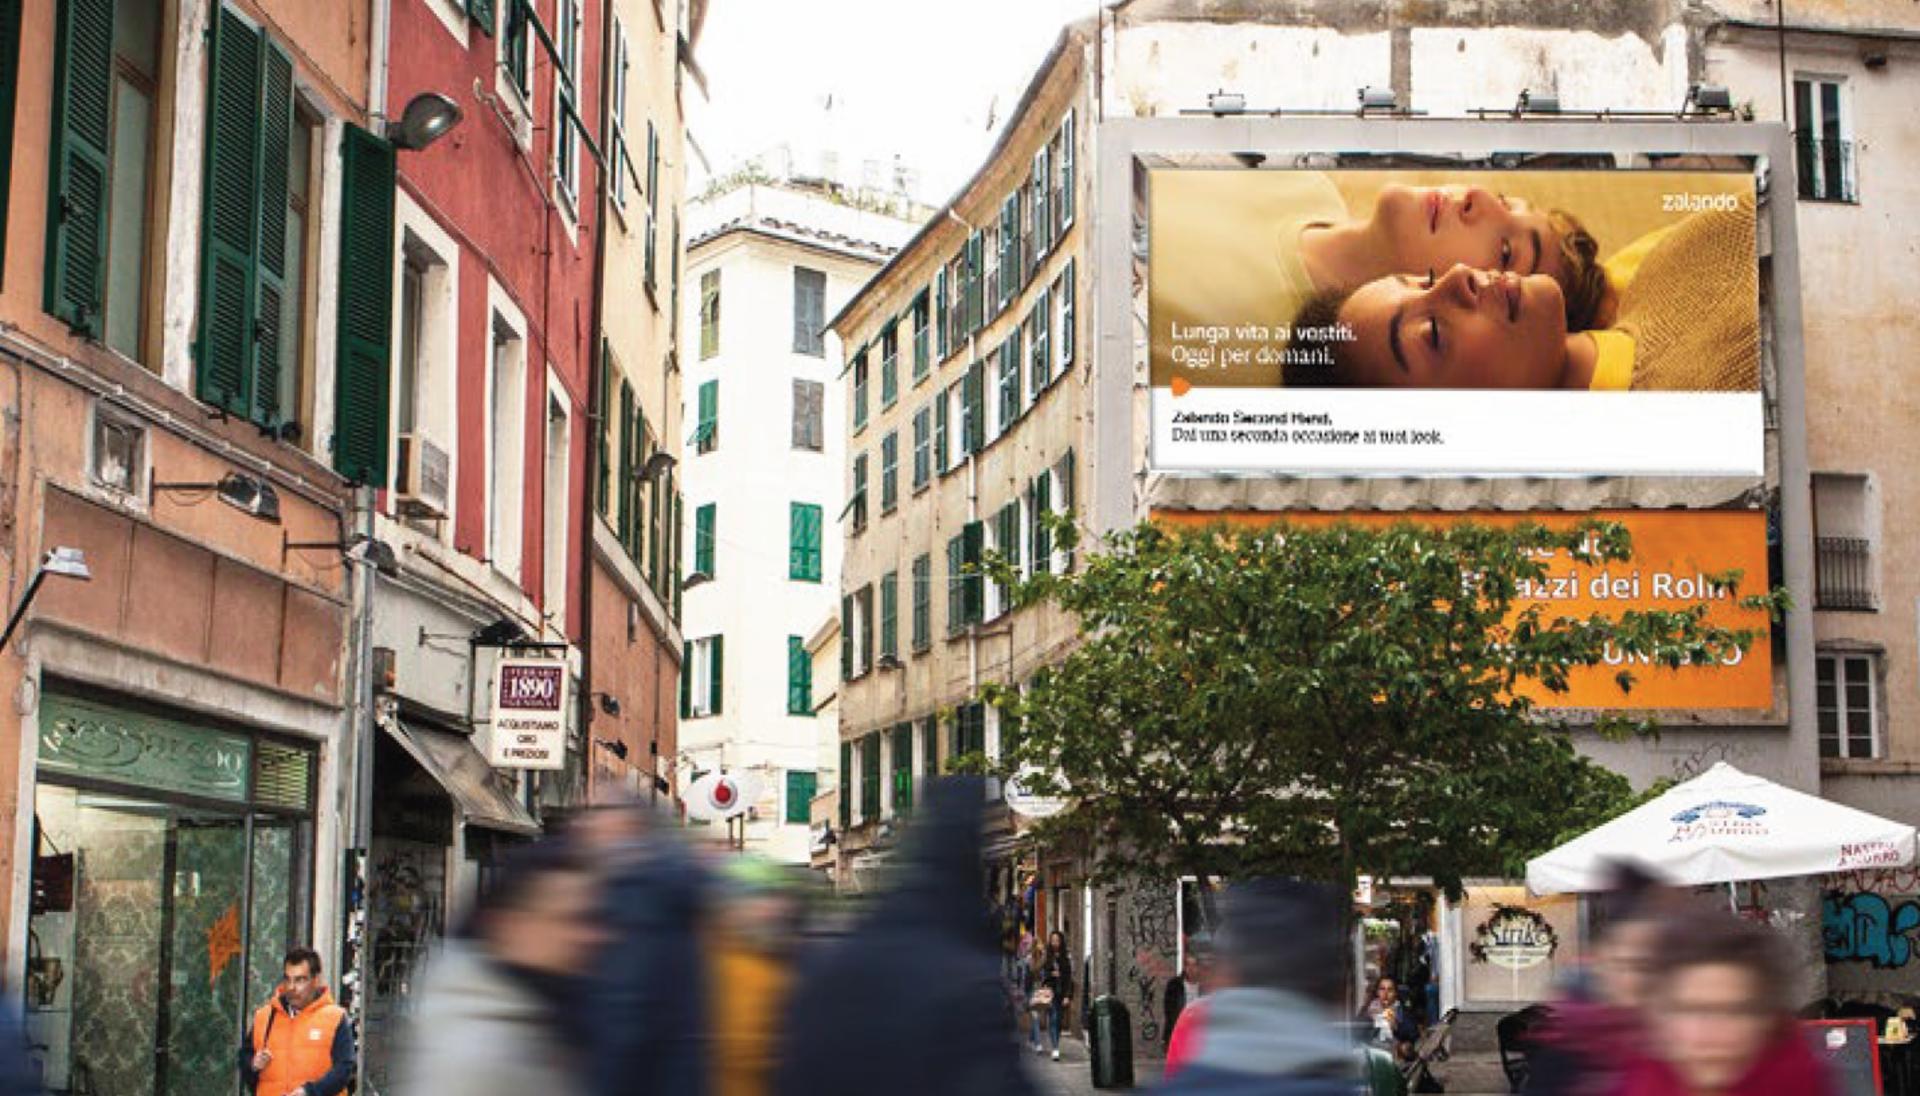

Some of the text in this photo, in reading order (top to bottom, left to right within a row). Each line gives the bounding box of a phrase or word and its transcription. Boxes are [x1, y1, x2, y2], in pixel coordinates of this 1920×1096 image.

[1662, 191, 1738, 212] zalando
[1171, 321, 1230, 345] Lunga
[1235, 322, 1269, 342] vita
[1274, 322, 1291, 341] ai
[1171, 344, 1336, 370] Oggi per domani.
[1233, 410, 1287, 425] Second
[1199, 429, 1227, 443] una
[1231, 428, 1288, 445] seconda
[1292, 430, 1359, 445] occasione
[1410, 429, 1445, 446] look.
[1589, 571, 1640, 599] dei
[511, 677, 554, 699] 1890
[497, 719, 560, 731] ACQUISTIAMO
